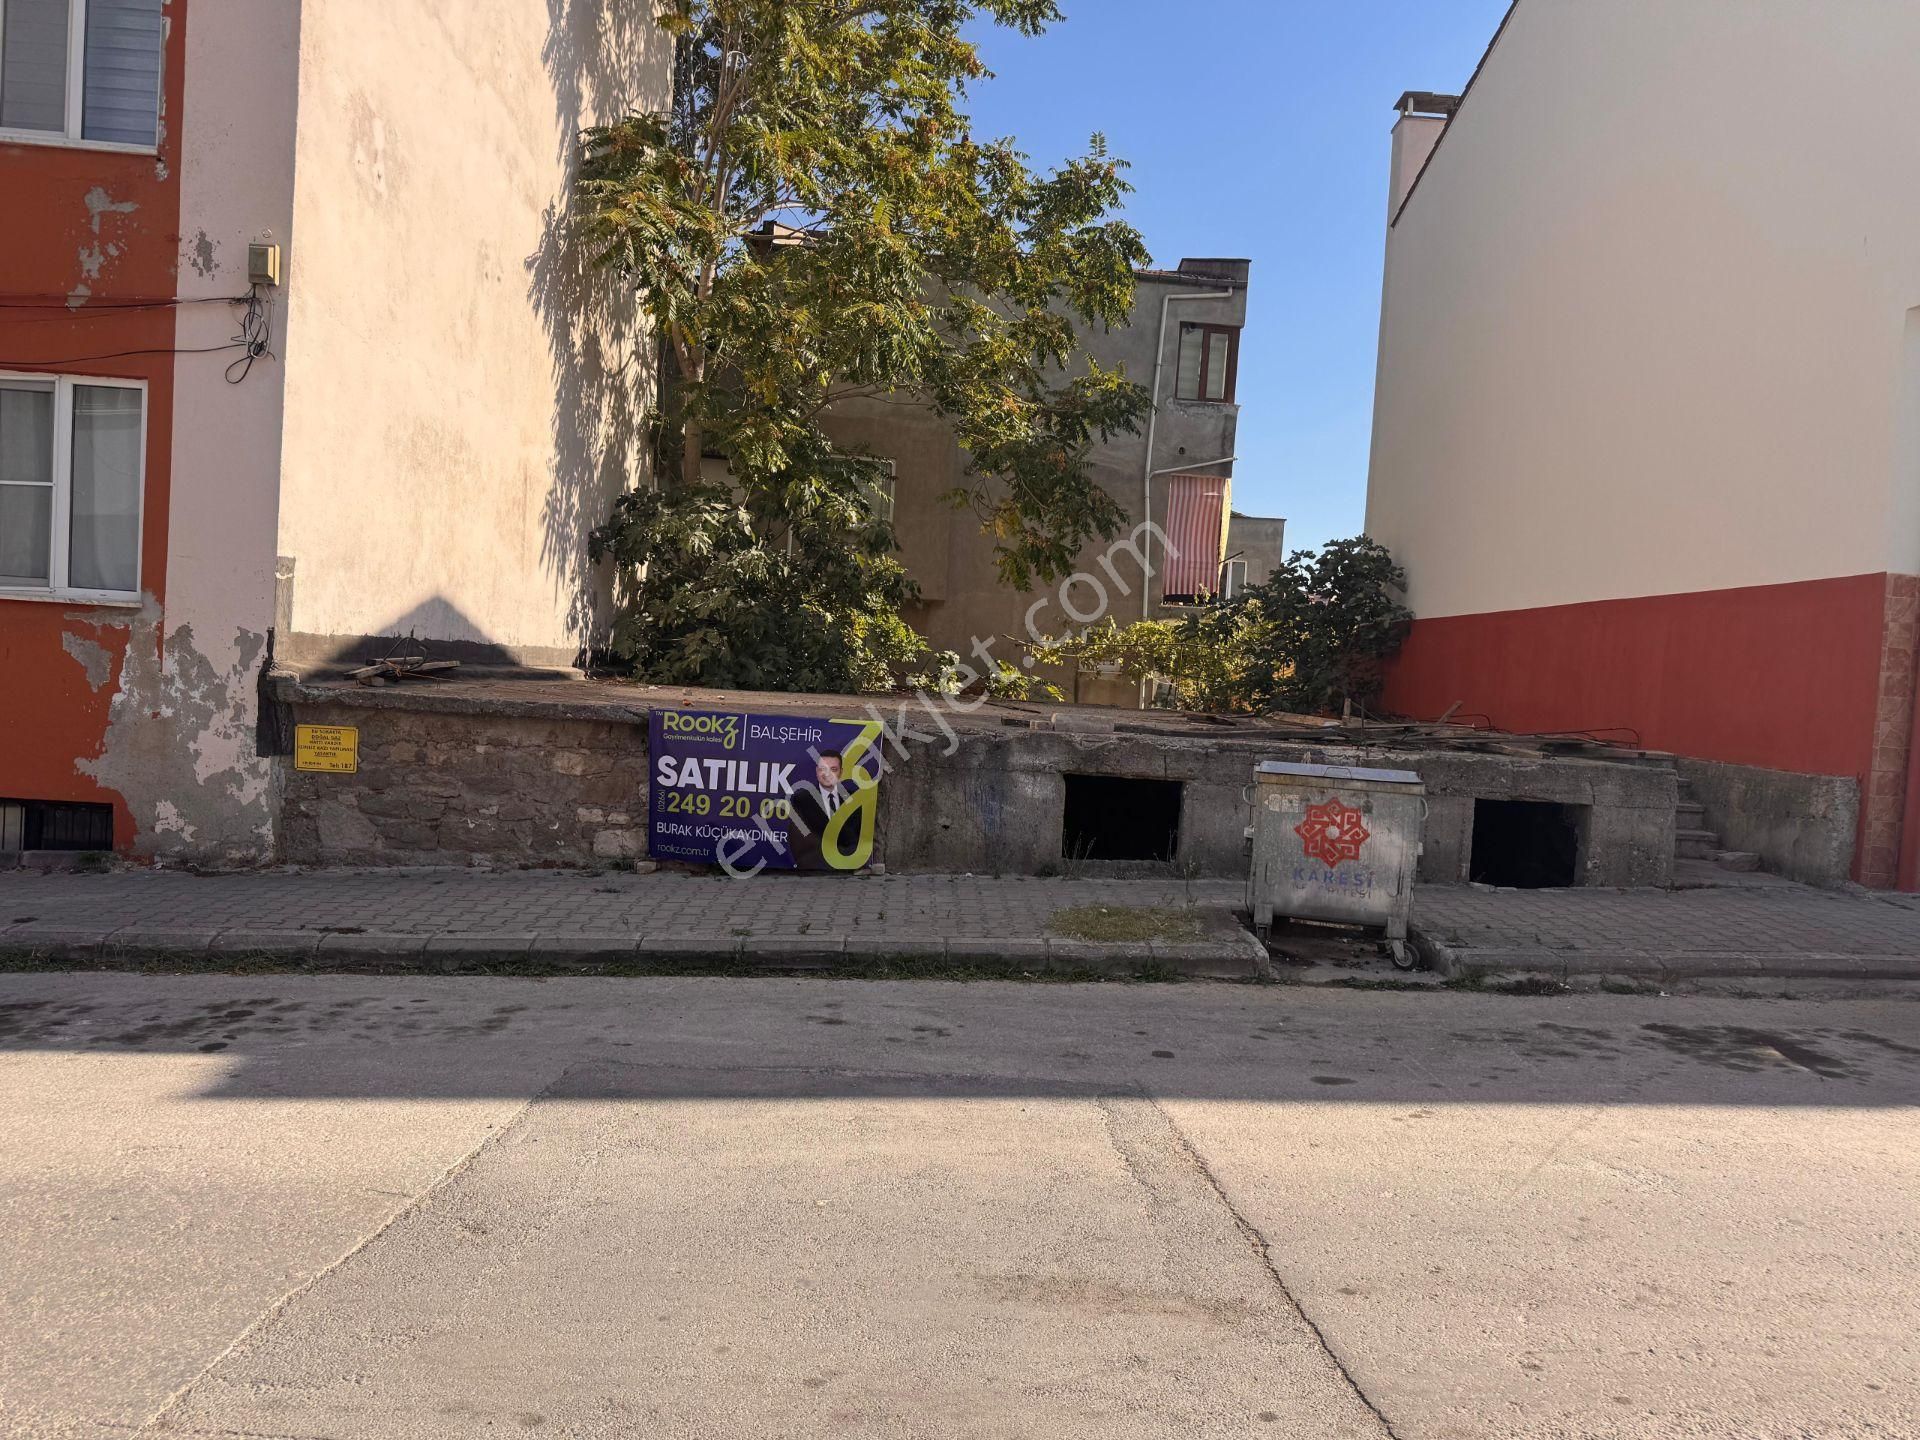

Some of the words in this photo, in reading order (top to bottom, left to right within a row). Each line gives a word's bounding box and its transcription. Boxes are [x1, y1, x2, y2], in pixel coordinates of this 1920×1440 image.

[663, 711, 739, 750] Rookz
[750, 724, 822, 744] BALŞEHİR
[656, 754, 797, 795] SATILIK
[666, 791, 711, 816] 249
[719, 795, 751, 818] 20
[759, 798, 792, 820] 00
[656, 821, 692, 837] BURAK
[657, 844, 710, 857] rookz.com.tr
